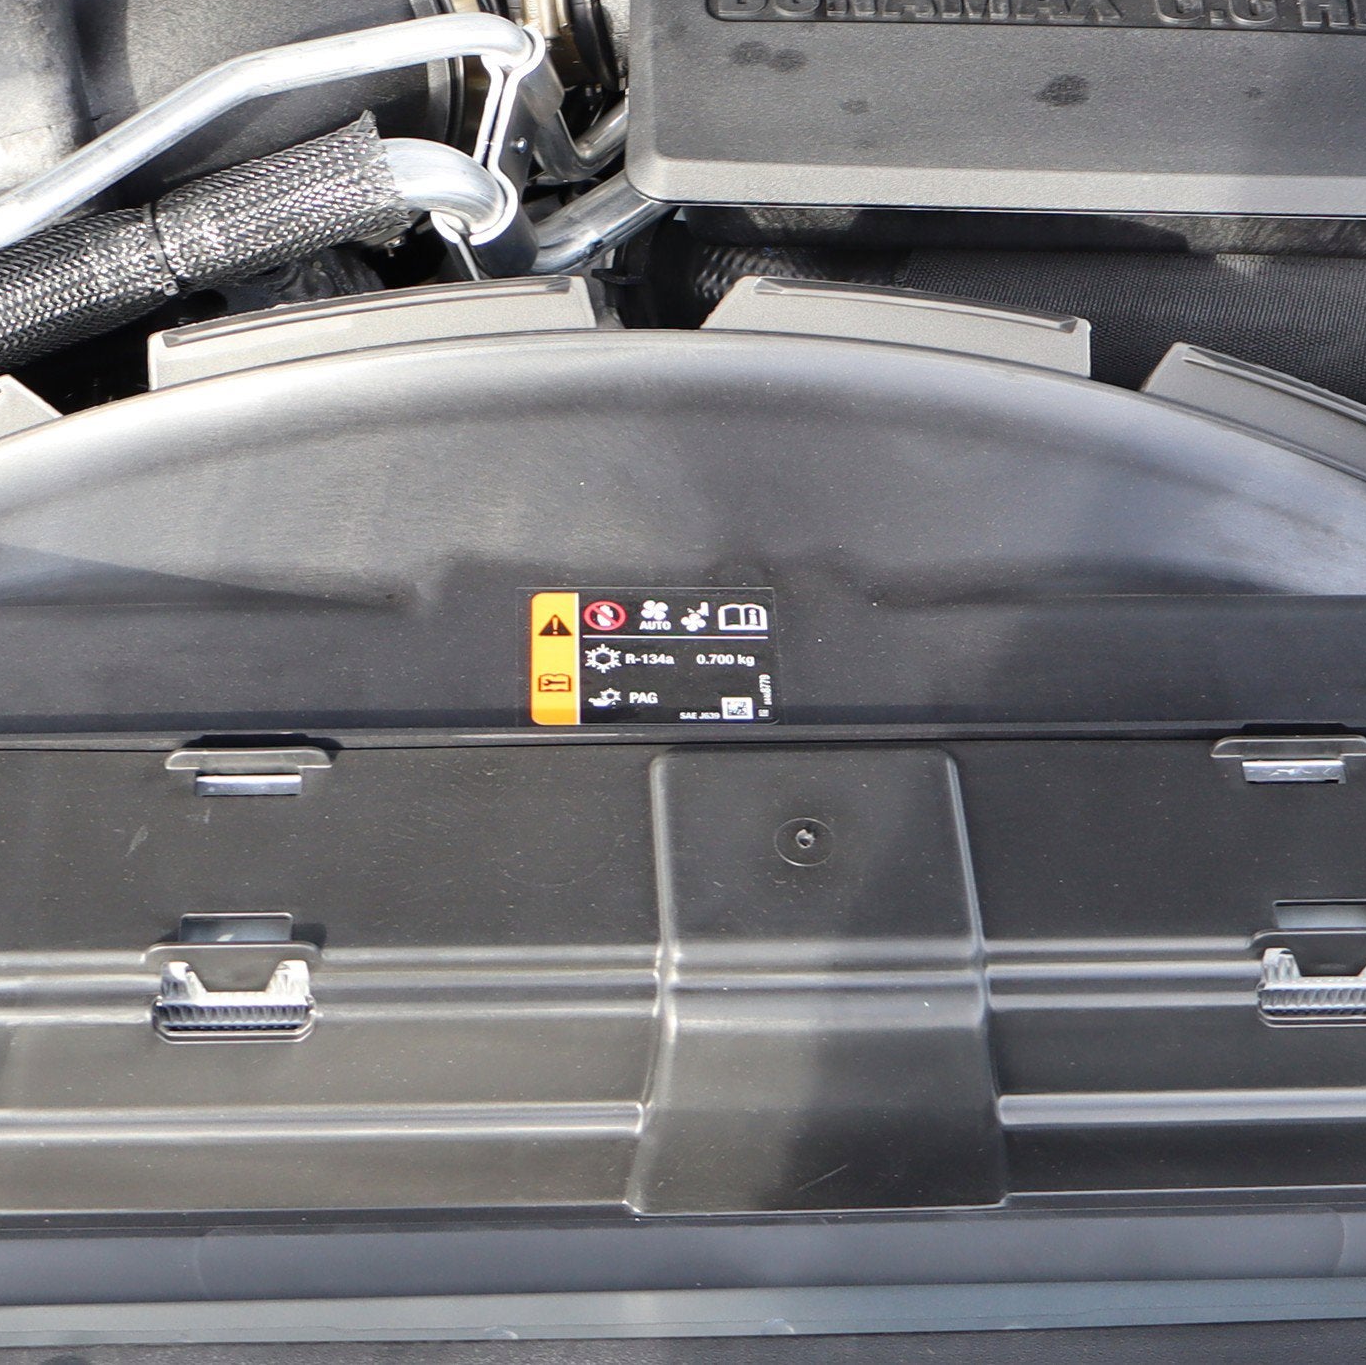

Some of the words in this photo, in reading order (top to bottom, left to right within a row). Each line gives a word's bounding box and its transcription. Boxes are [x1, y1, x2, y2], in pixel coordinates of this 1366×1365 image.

[639, 620, 672, 631] AUTO
[625, 653, 675, 666] R-134a
[696, 653, 735, 666] 0.700
[737, 653, 756, 668] kg
[629, 691, 659, 705] PAG
[679, 712, 697, 720] SAE
